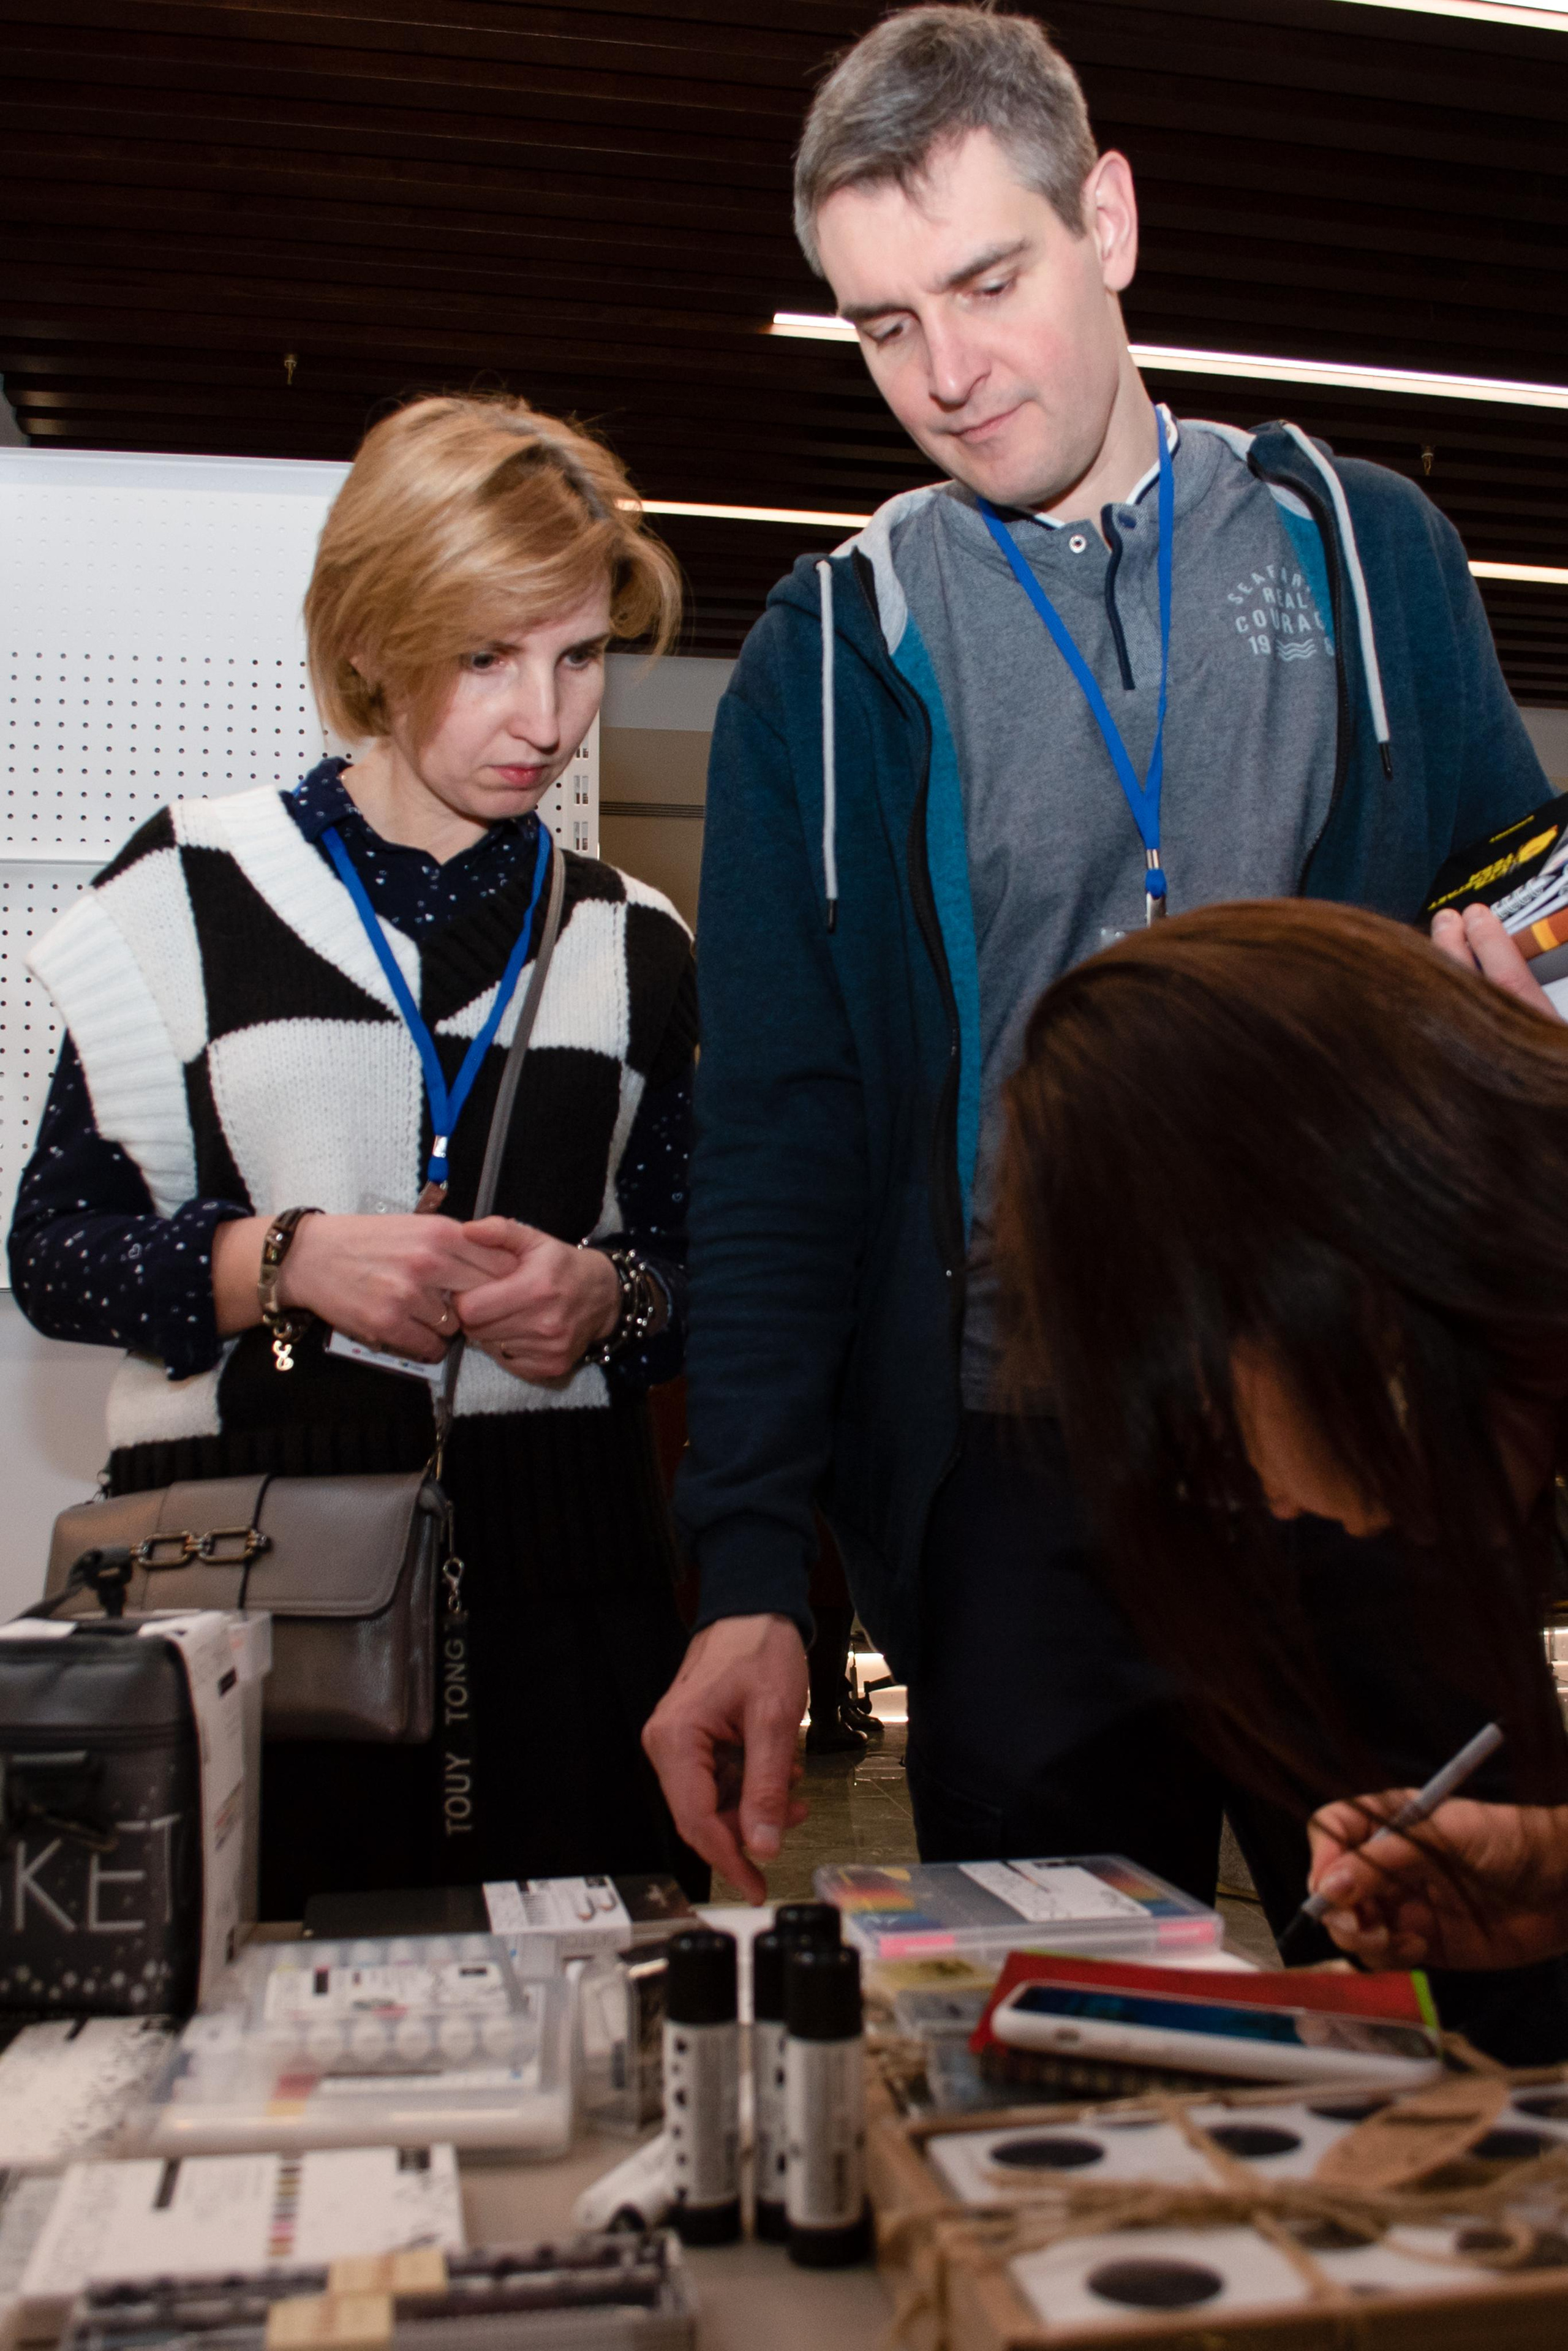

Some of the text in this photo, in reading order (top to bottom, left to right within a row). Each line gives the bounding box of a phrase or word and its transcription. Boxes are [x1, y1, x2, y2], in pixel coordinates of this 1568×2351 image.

[1262, 587, 1308, 609] REAL
[444, 1638, 469, 1726] TONG
[444, 1752, 472, 1836] TOUY
